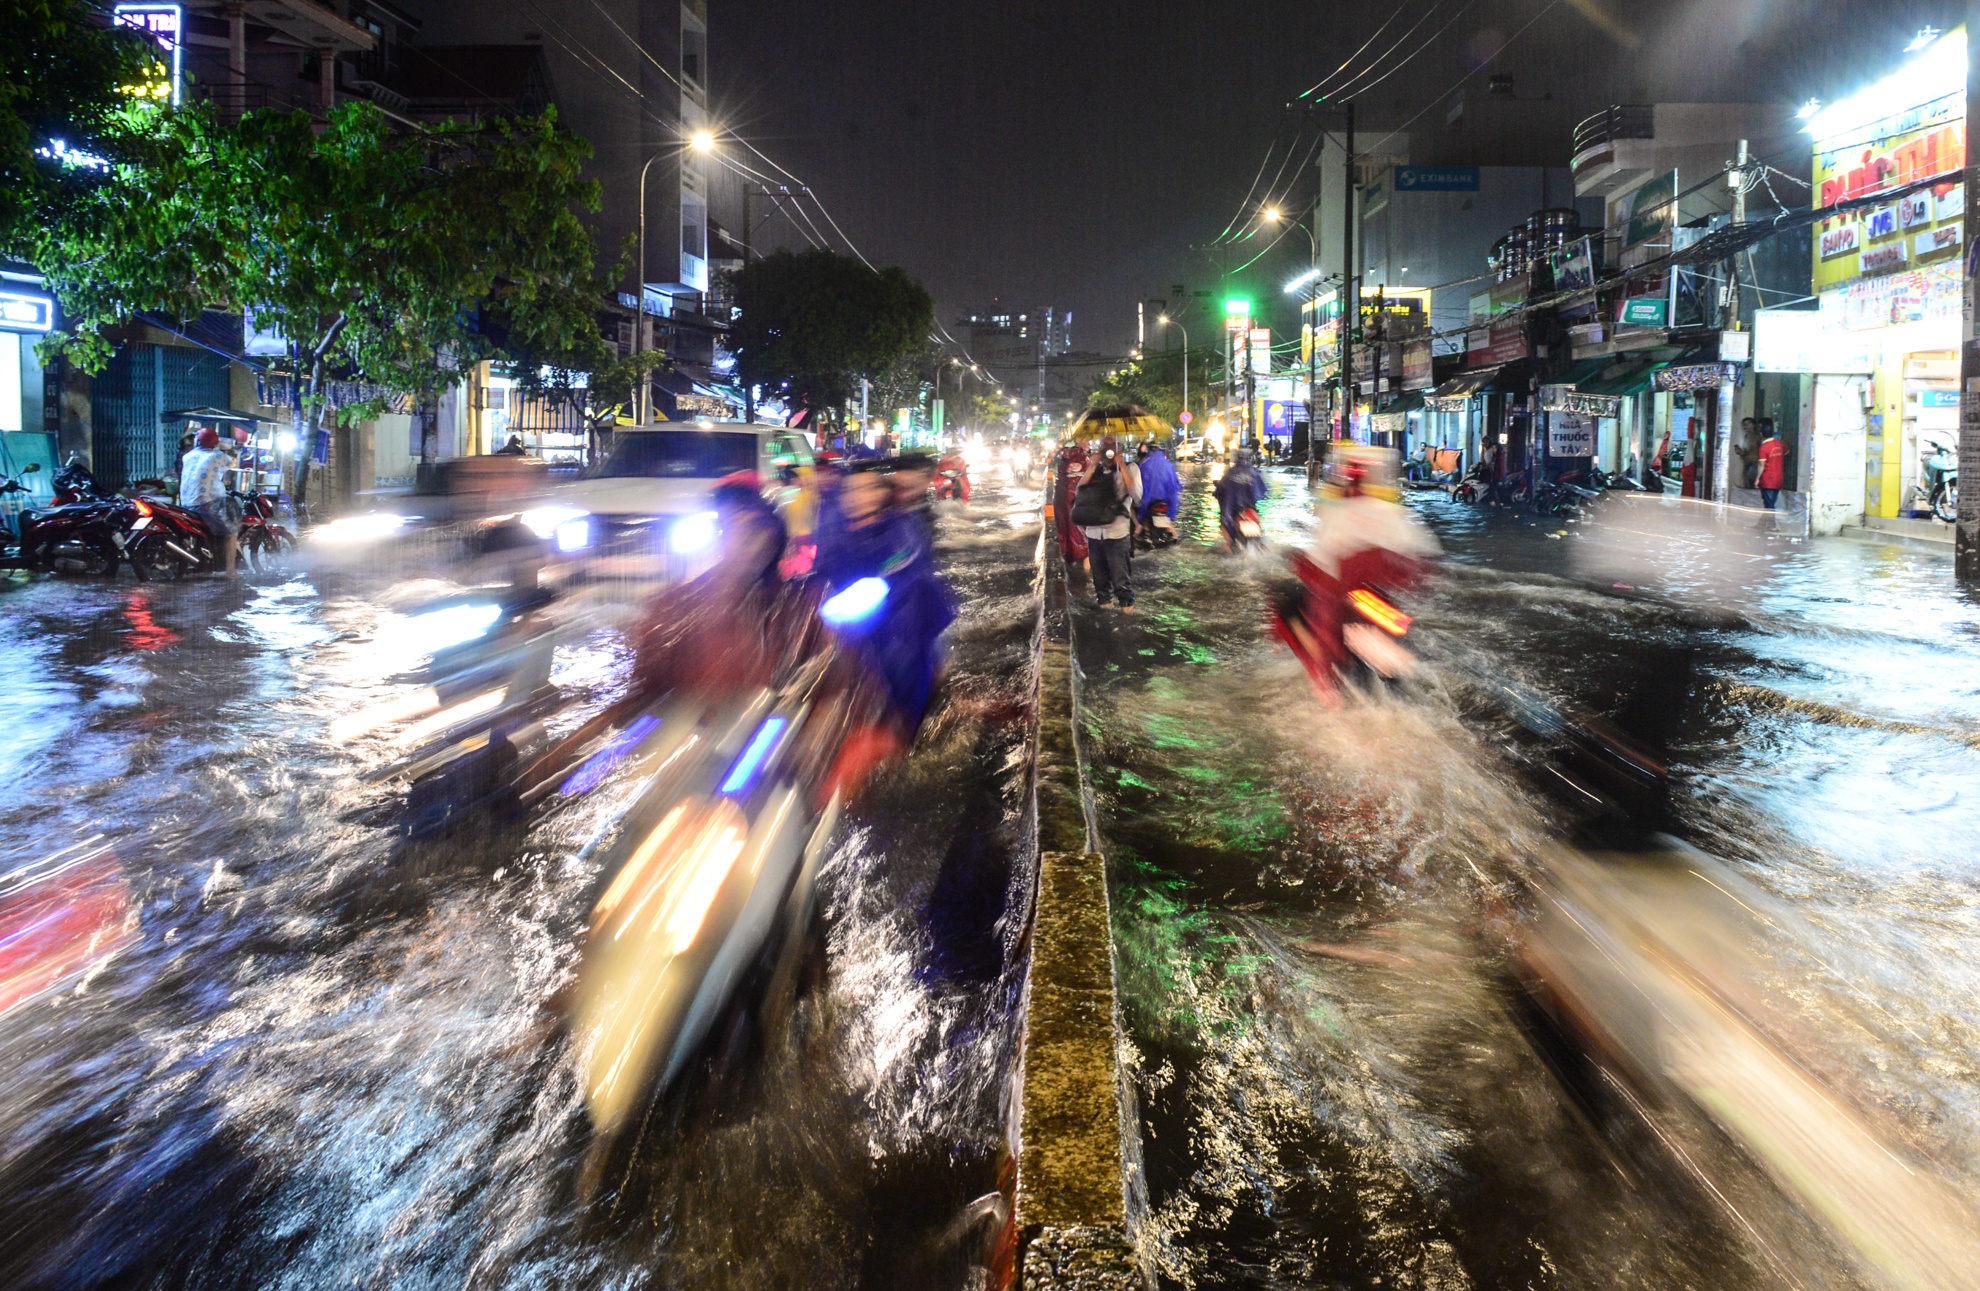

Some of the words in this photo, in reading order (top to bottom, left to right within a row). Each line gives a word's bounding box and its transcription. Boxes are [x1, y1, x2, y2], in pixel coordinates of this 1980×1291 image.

[1420, 173, 1473, 183] EXIMBANK
[1913, 201, 1926, 220] LG
[1868, 211, 1892, 237] JVC
[1822, 229, 1854, 255] SANYO
[1862, 245, 1900, 269] TOSHIBA
[1552, 430, 1589, 441] THUỐC
[1560, 444, 1582, 454] TÂY
